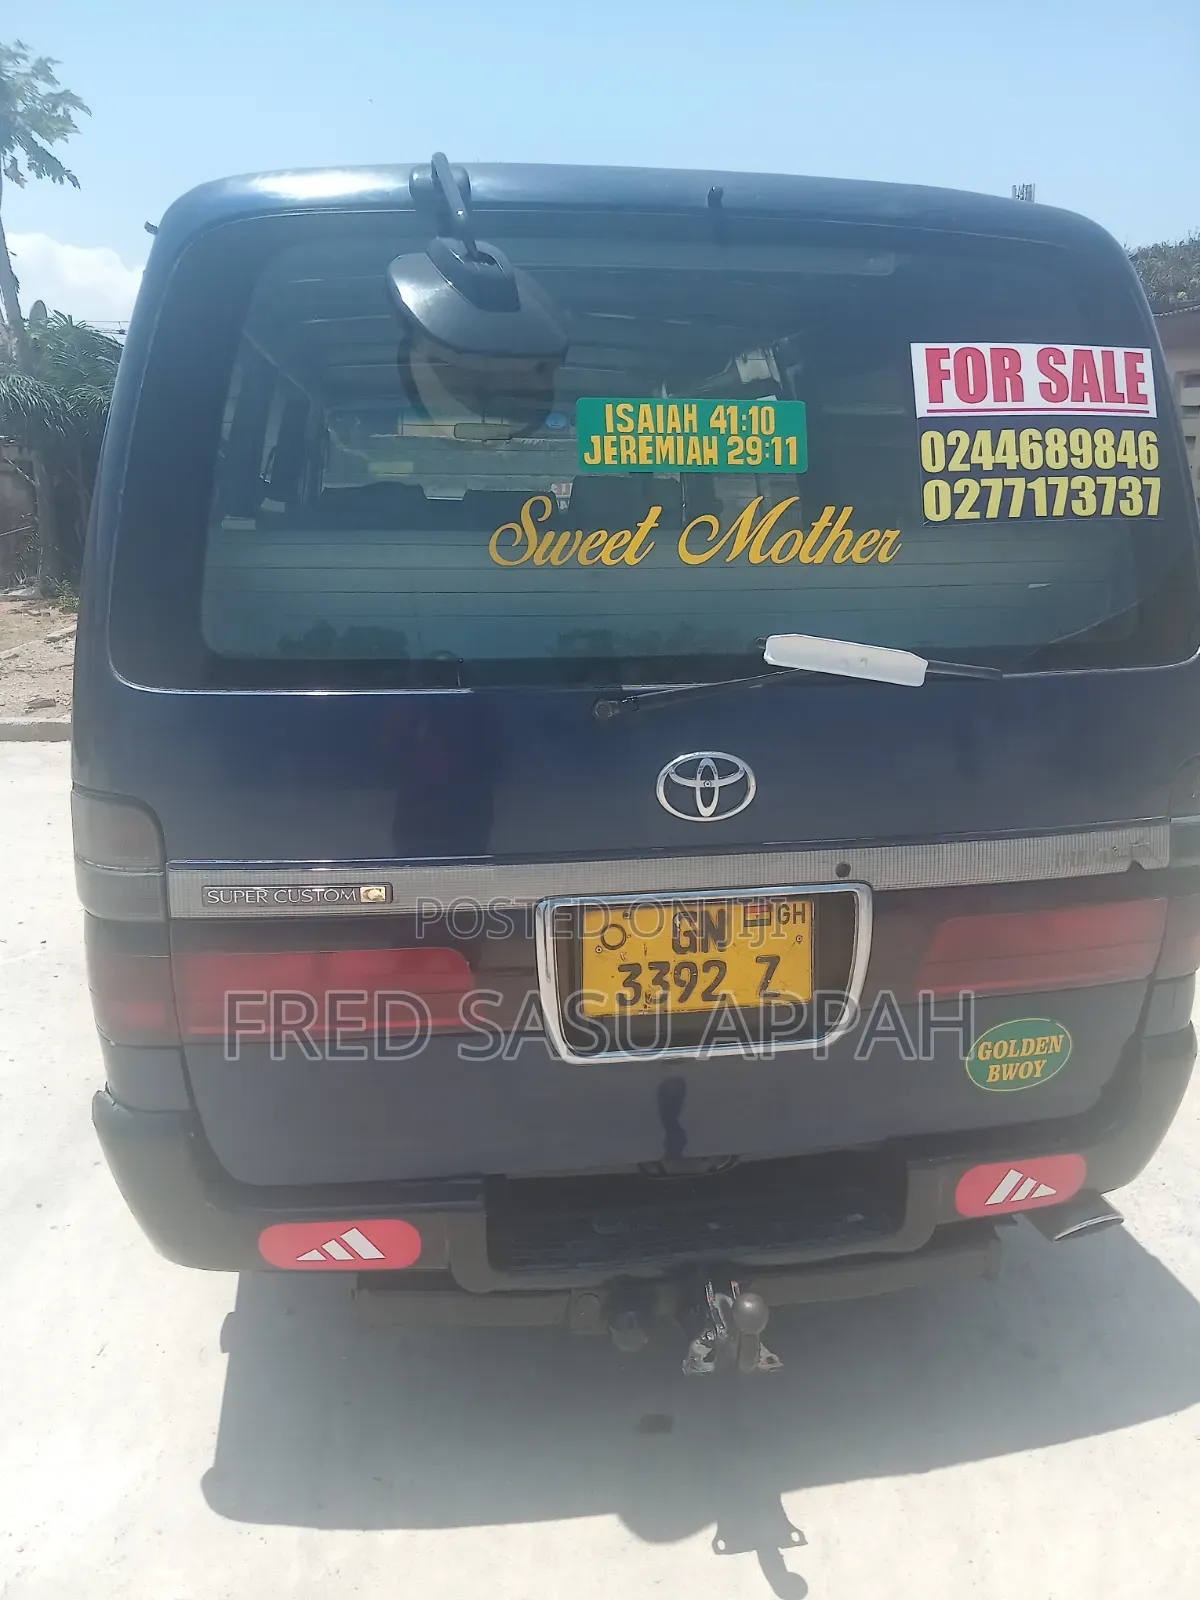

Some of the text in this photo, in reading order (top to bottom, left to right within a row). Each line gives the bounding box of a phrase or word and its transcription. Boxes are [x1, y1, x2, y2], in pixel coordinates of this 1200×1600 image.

[925, 346, 1149, 404] FOR SALE
[604, 403, 776, 435] ISAIAH 41:10
[583, 435, 798, 466] JEREMIAH 29:11
[920, 428, 1159, 473] 0244689846
[923, 475, 1161, 522] 0277173737
[489, 495, 662, 567] Sweet
[678, 495, 902, 566] Mother
[206, 889, 268, 904] SUPER
[273, 888, 358, 903] CUSTOM
[777, 902, 807, 925] GH
[671, 908, 729, 955] GN
[616, 955, 781, 1007] 3392 Z
[976, 1034, 1065, 1061] GOLDEN
[985, 1058, 1048, 1084] BWOY
